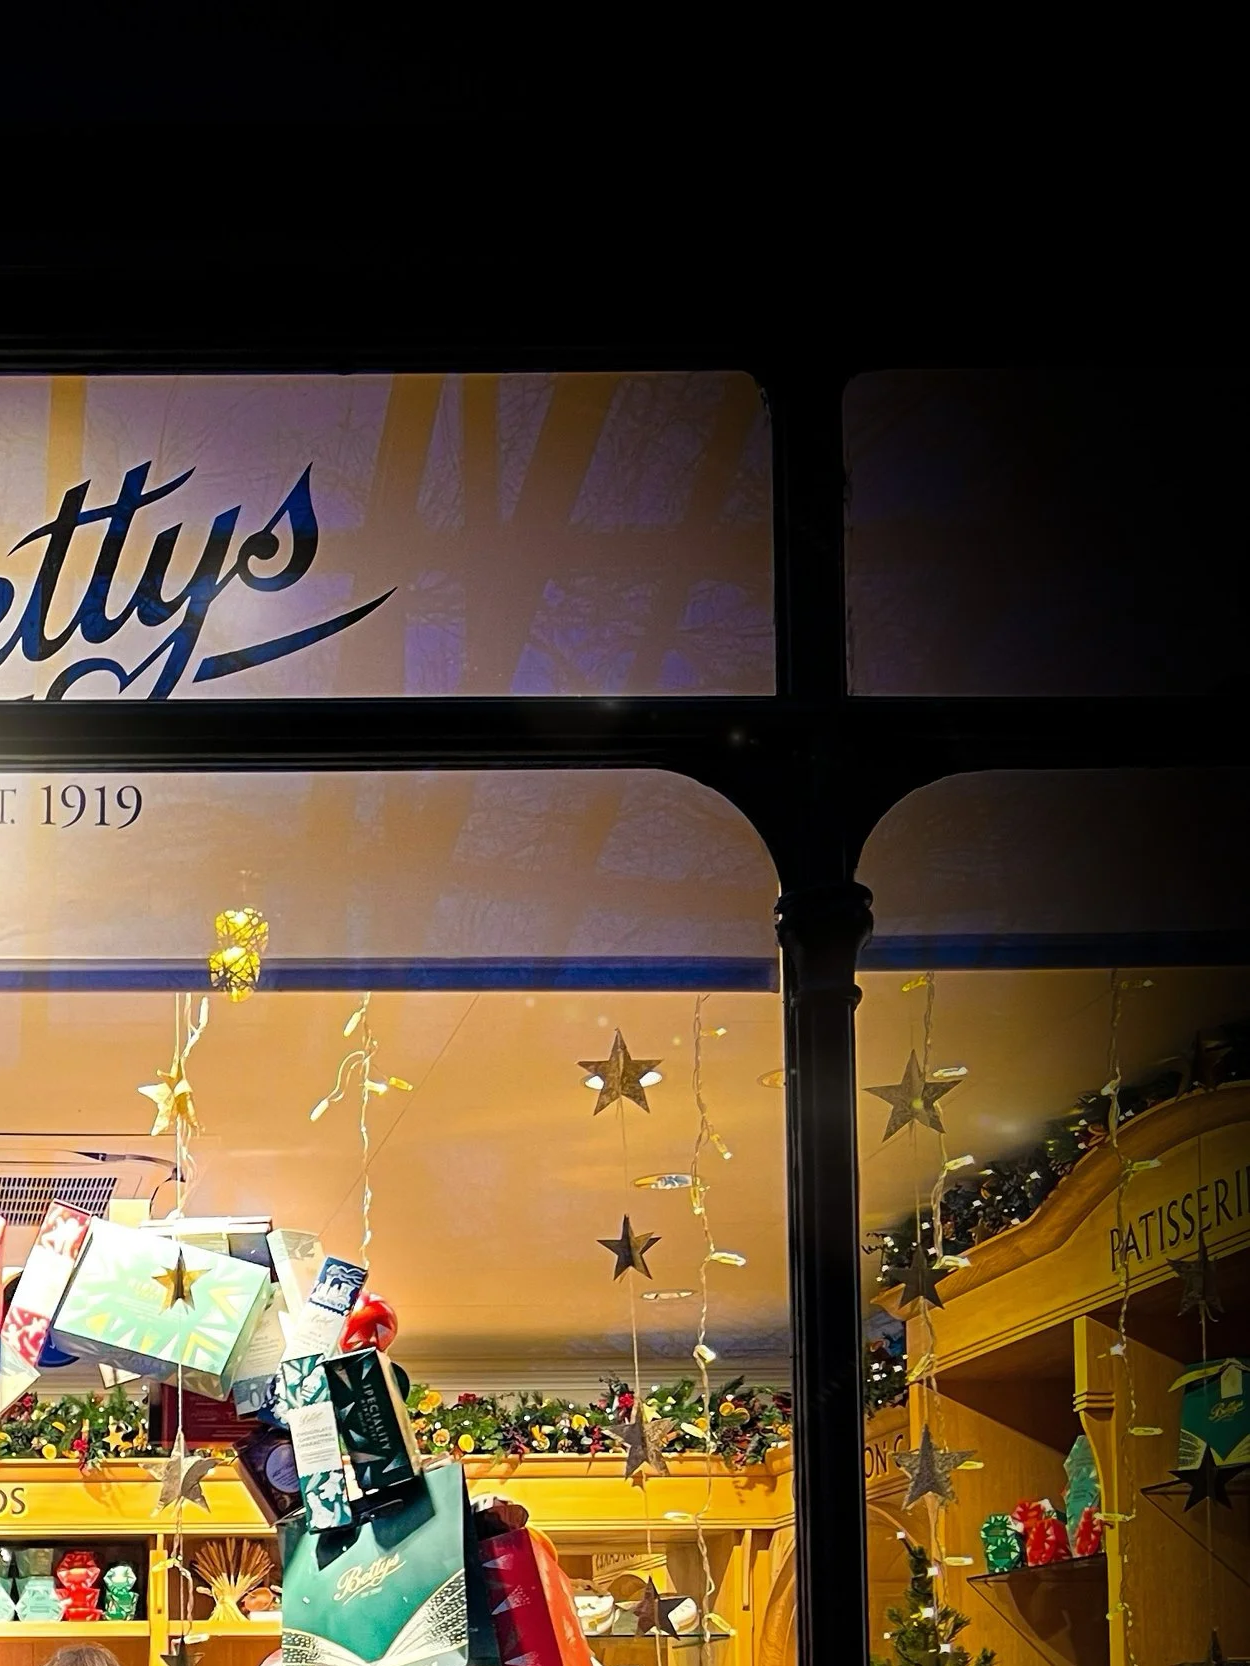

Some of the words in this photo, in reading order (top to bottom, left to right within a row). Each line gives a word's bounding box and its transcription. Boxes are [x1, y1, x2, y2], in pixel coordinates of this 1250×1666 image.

[40, 783, 144, 830] 1919
[1110, 1165, 1250, 1273] PATISSERI
[333, 1552, 407, 1606] Bettys
